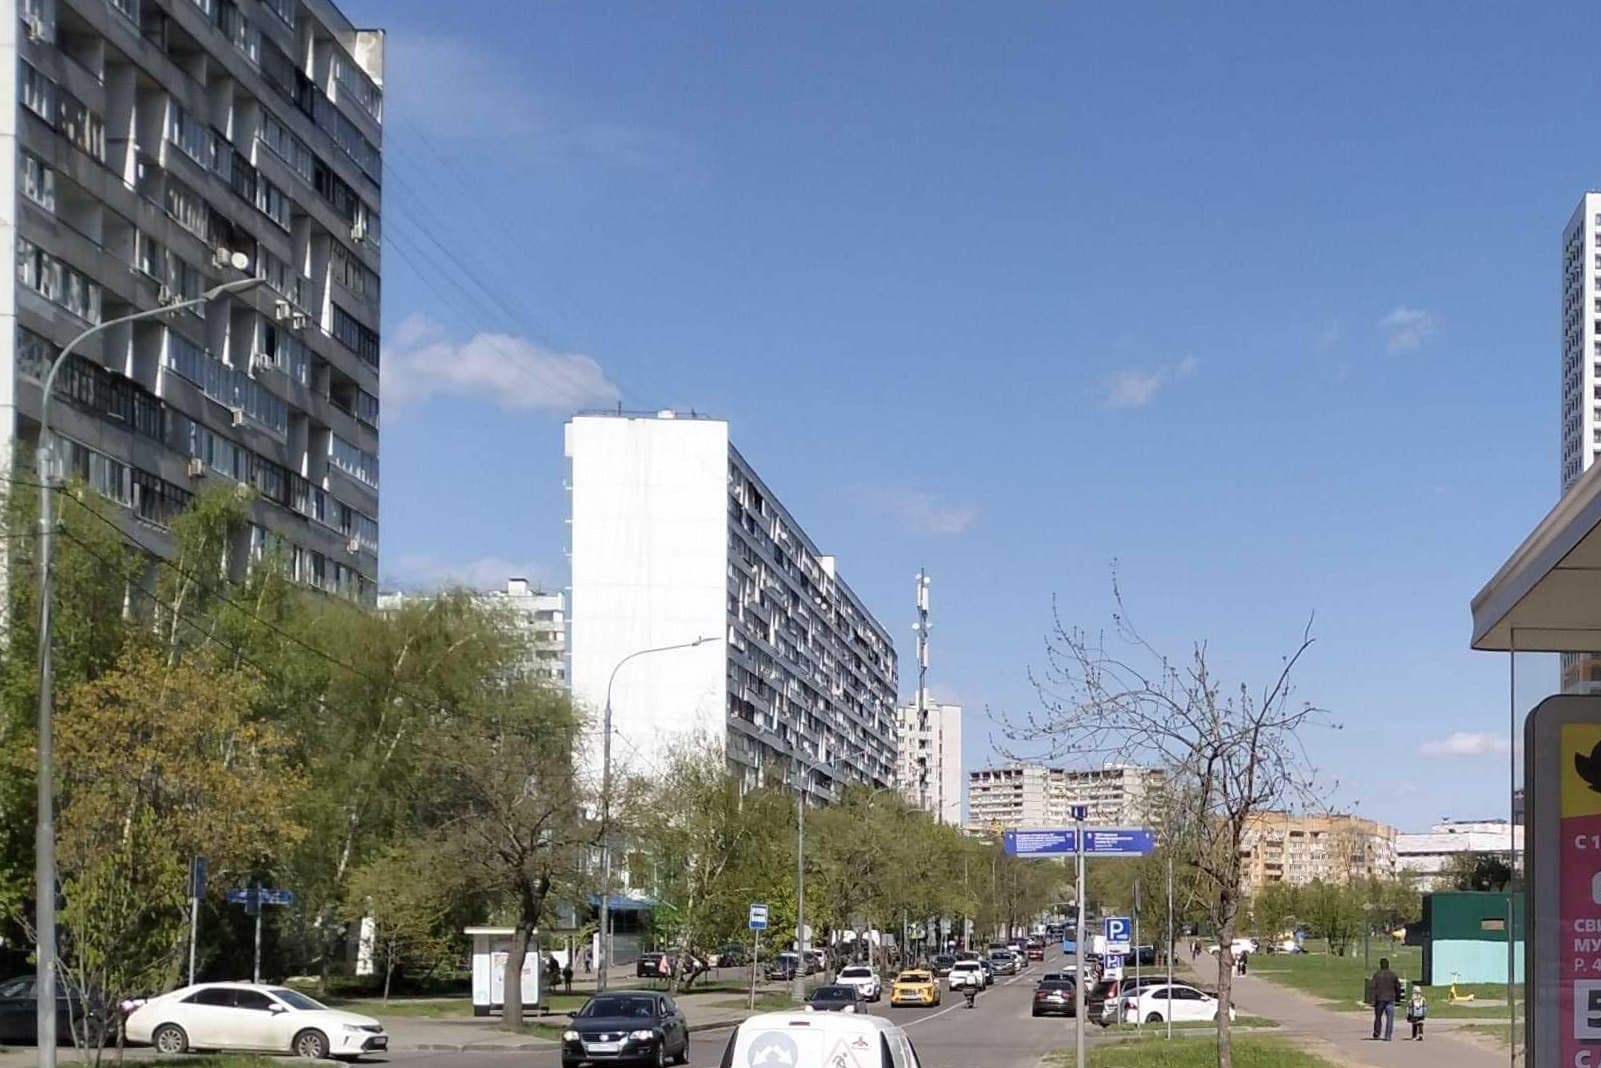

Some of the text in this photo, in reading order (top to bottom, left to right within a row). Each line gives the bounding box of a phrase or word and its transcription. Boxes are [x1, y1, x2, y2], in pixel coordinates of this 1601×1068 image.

[1574, 834, 1587, 850] С
[1591, 835, 1600, 850] 1
[1109, 921, 1124, 940] P
[1574, 957, 1587, 973] Р.
